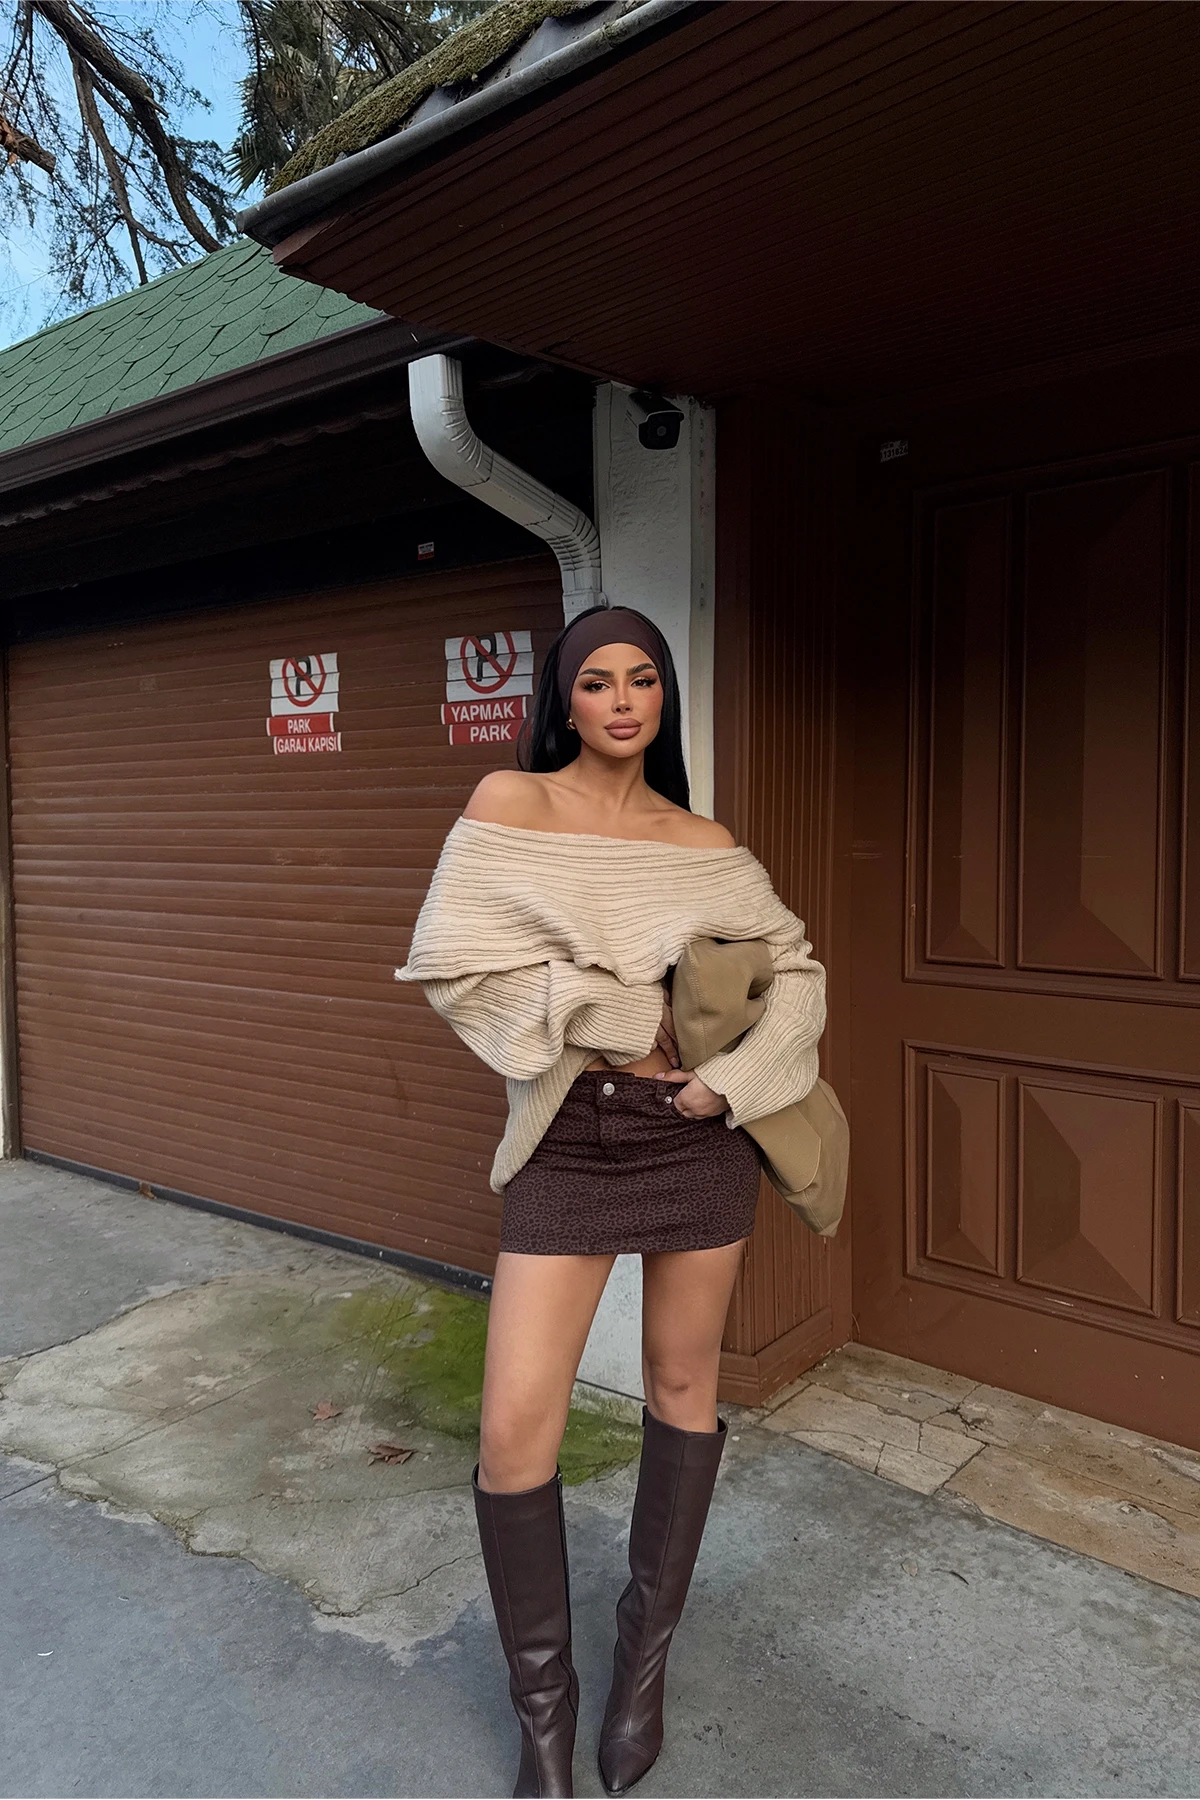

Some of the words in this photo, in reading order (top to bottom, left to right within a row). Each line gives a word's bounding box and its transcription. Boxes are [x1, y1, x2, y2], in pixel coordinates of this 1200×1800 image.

[451, 701, 515, 722] YAPMAK
[287, 718, 312, 734] PARK
[470, 723, 512, 742] PARK
[277, 737, 307, 753] GARAJ
[308, 736, 337, 752] KAPISI
